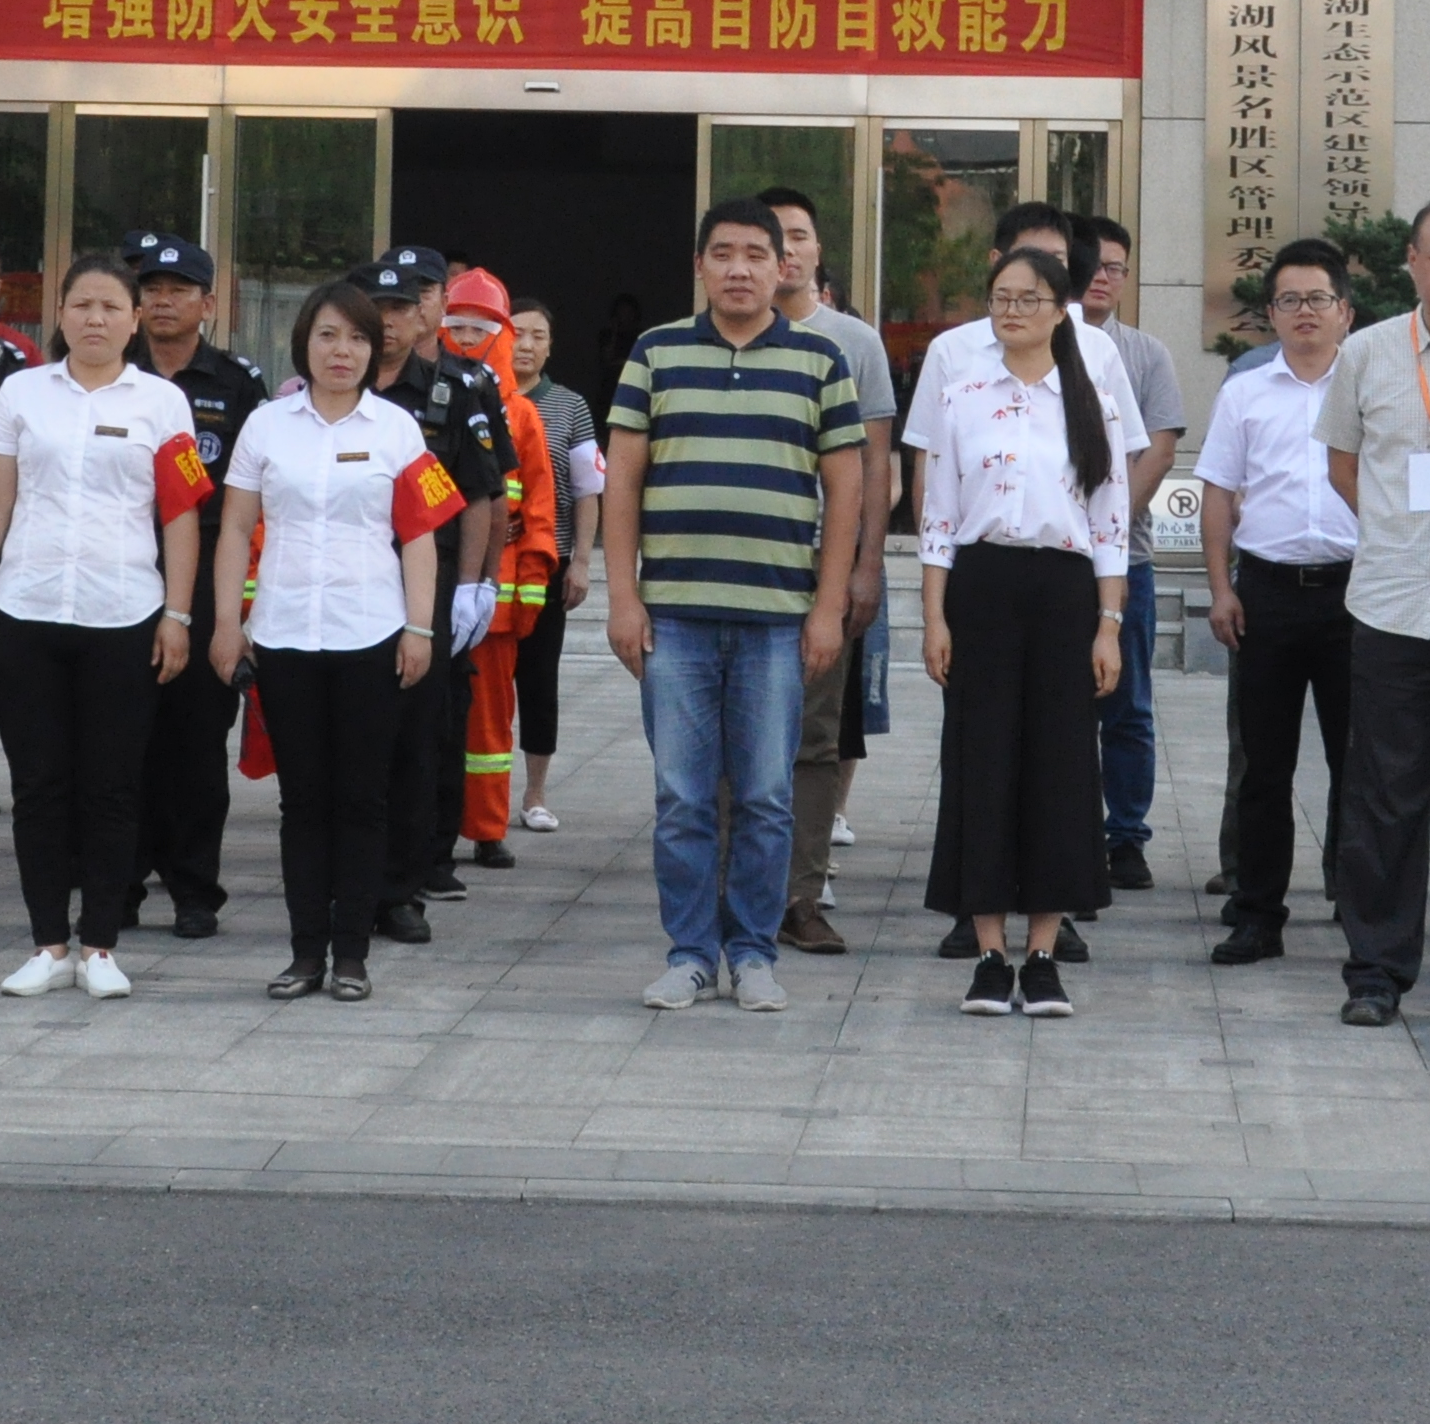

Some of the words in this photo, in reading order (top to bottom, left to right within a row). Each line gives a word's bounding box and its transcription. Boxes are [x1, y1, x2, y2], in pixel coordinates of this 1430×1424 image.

[1157, 521, 1201, 535] 小心地
[1157, 538, 1170, 547] NO
[1173, 538, 1201, 547] PARKI
